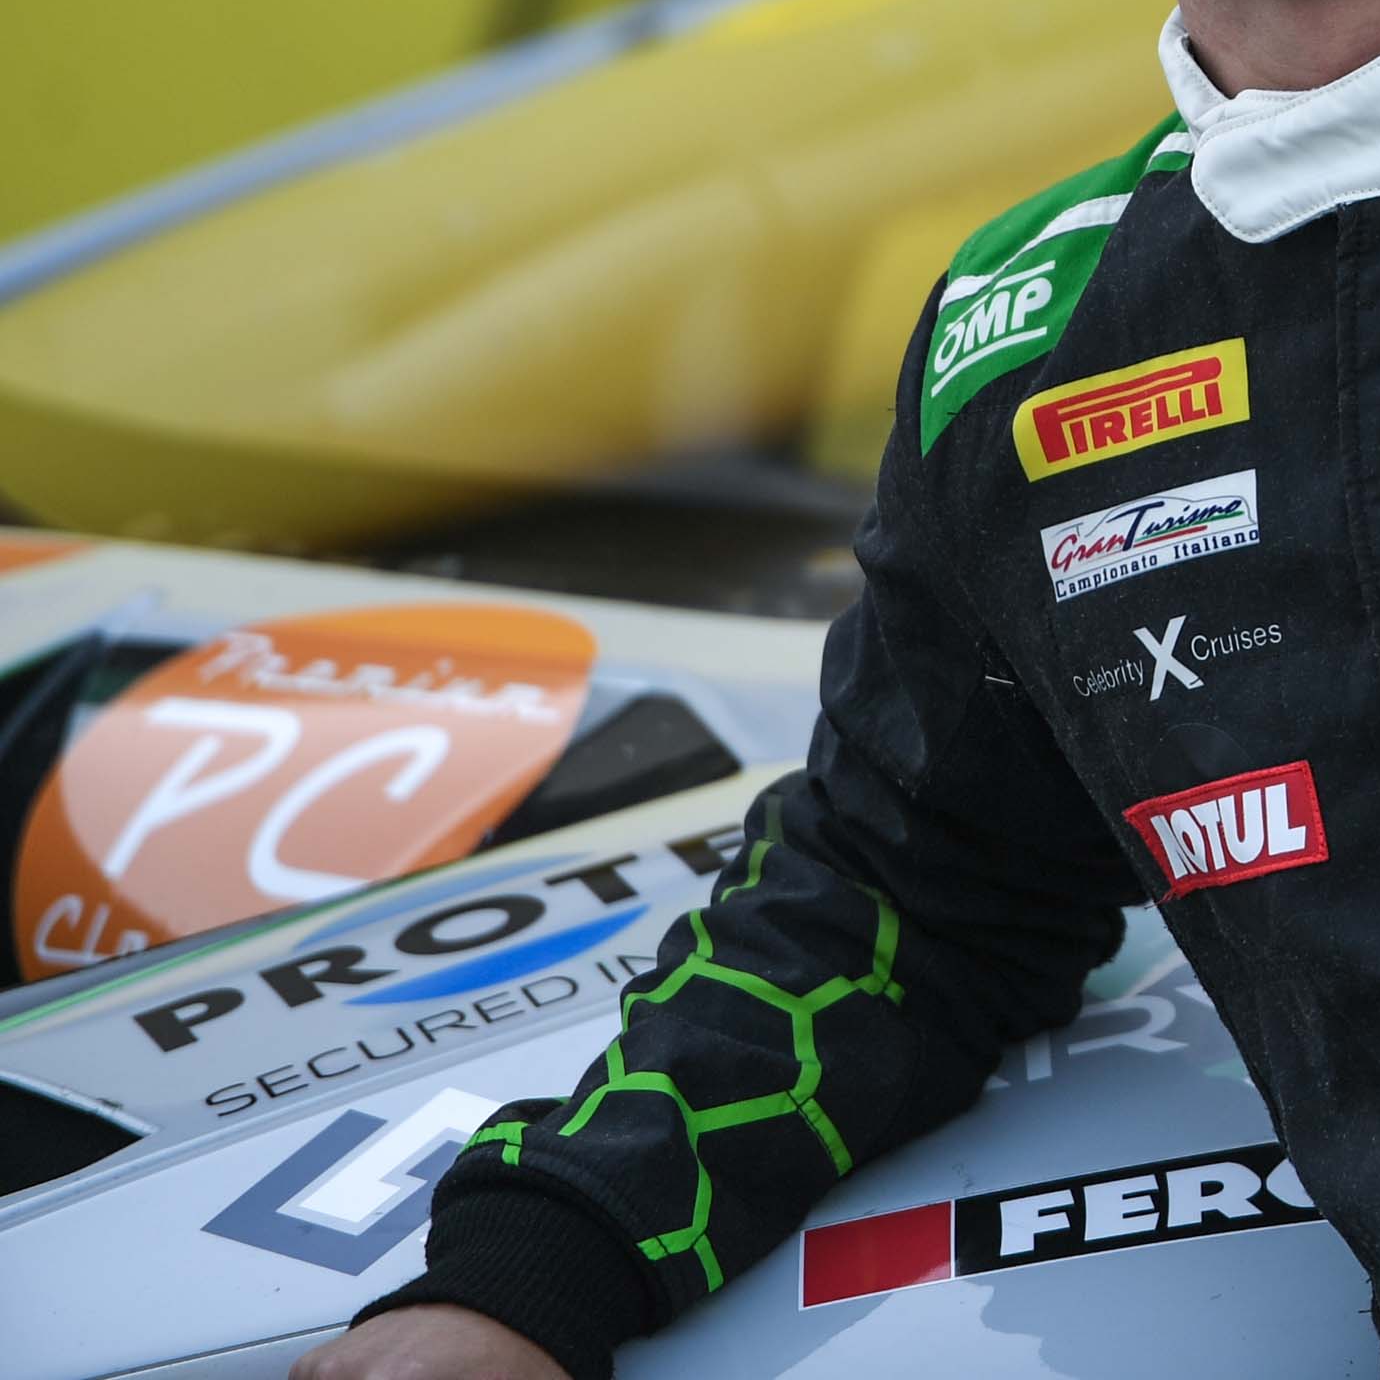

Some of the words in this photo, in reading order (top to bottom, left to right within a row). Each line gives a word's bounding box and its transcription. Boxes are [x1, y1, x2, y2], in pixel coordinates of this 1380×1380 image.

[932, 277, 1053, 375] OMP
[1032, 356, 1224, 464] PIRELLI
[1056, 555, 1158, 599] Campionato
[1173, 528, 1260, 560] Italiano
[1073, 659, 1144, 698] Celebrity
[1133, 615, 1204, 702] X
[1190, 622, 1283, 662] Cruises
[102, 695, 451, 903] PC
[203, 974, 581, 1119] SECURED
